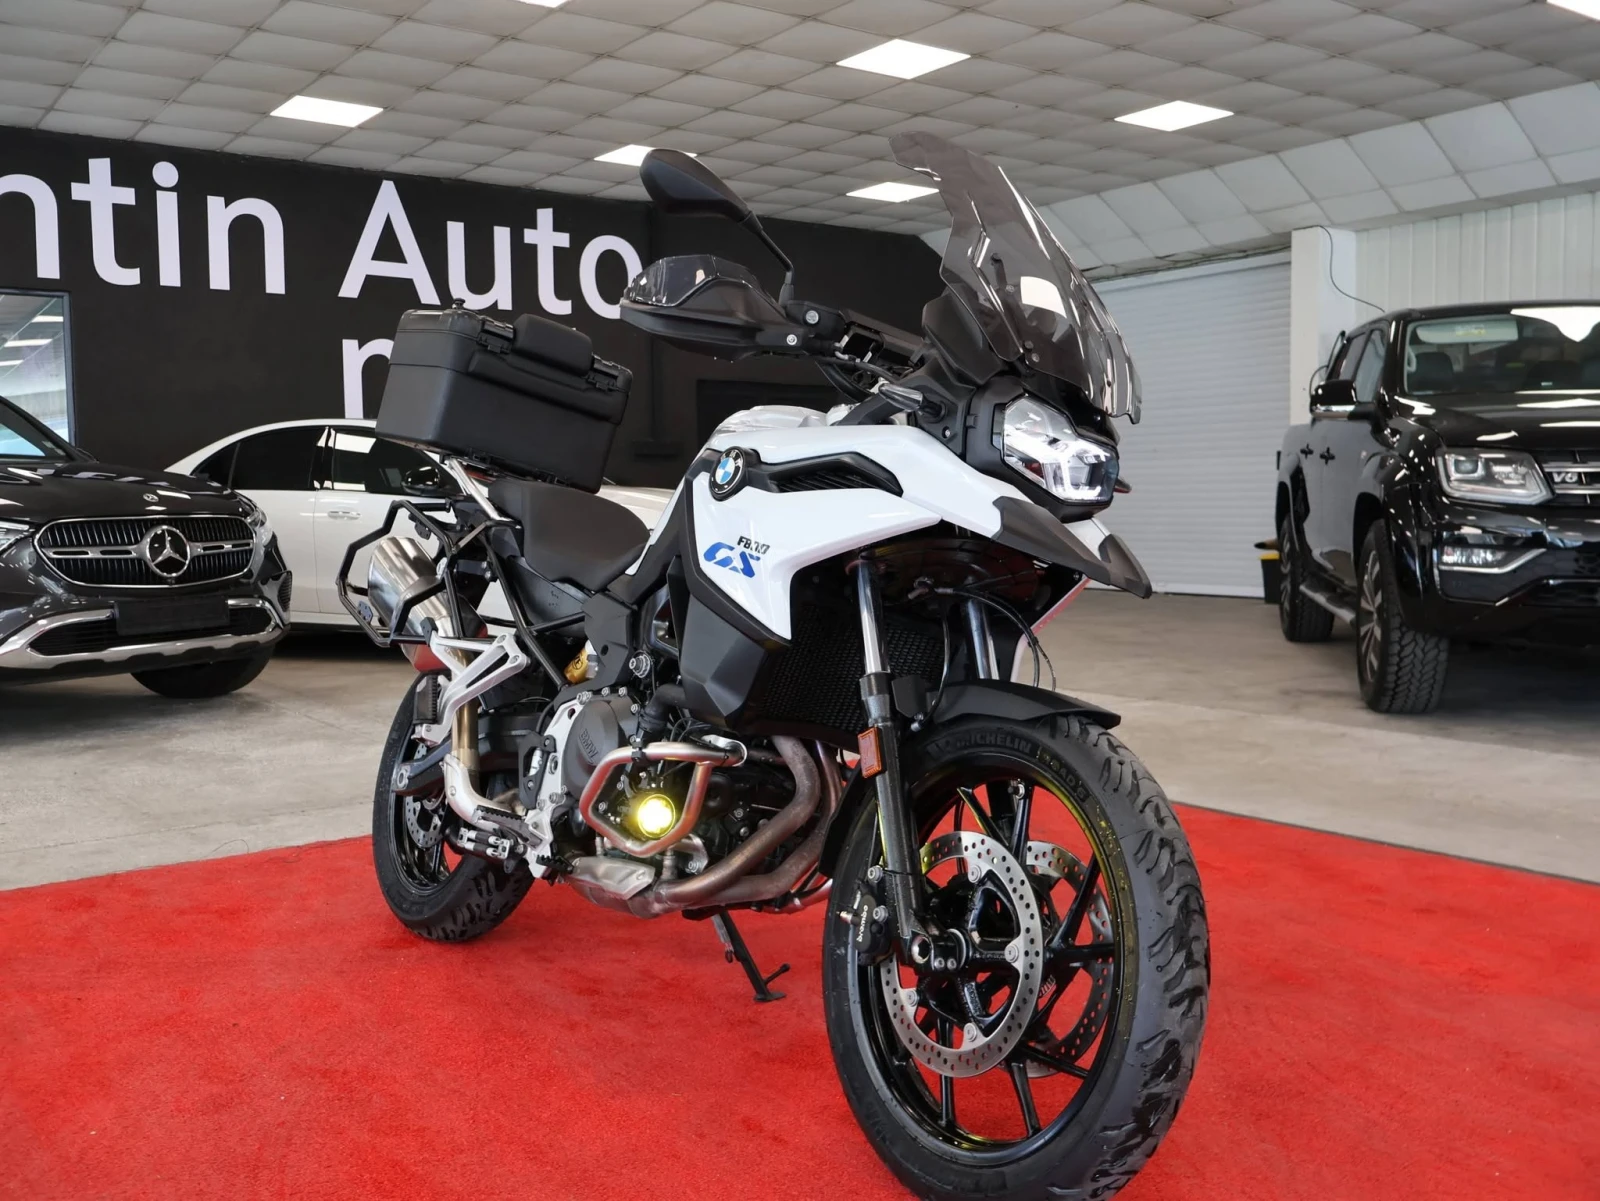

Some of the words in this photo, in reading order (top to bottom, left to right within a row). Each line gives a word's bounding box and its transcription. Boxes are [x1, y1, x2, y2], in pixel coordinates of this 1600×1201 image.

[337, 179, 643, 320] Auto
[1552, 472, 1579, 483] V6
[703, 541, 761, 578] GS
[580, 728, 599, 758] BMW
[956, 732, 1033, 754] MICHELIN
[856, 905, 868, 941] brembo
